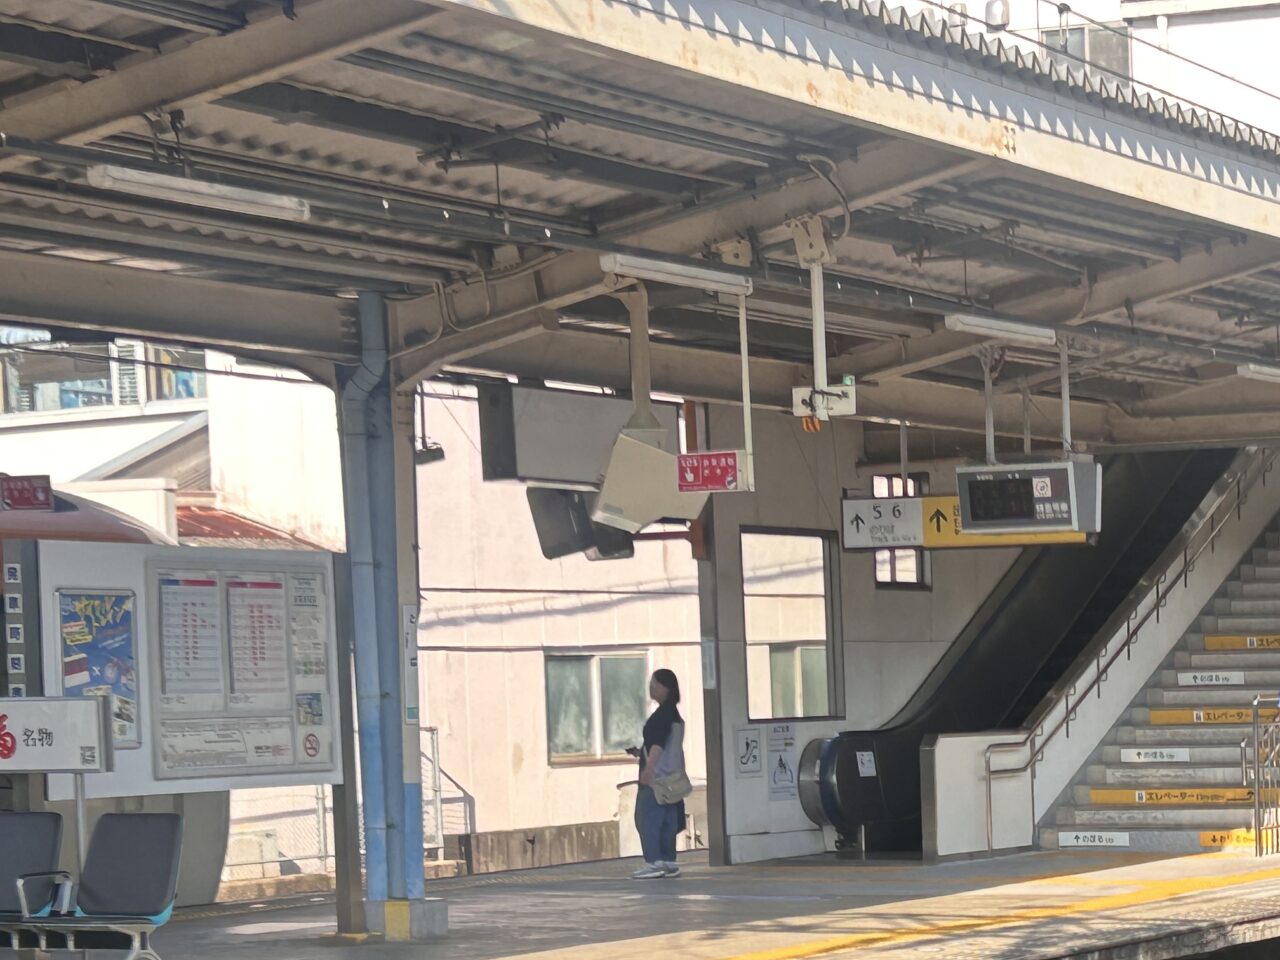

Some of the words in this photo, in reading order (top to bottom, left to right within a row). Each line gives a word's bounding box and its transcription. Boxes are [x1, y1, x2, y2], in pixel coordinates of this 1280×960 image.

[873, 504, 882, 519] 5
[892, 504, 901, 518] 6
[23, 728, 54, 747] 名物
[1147, 791, 1195, 801] エレベーター
